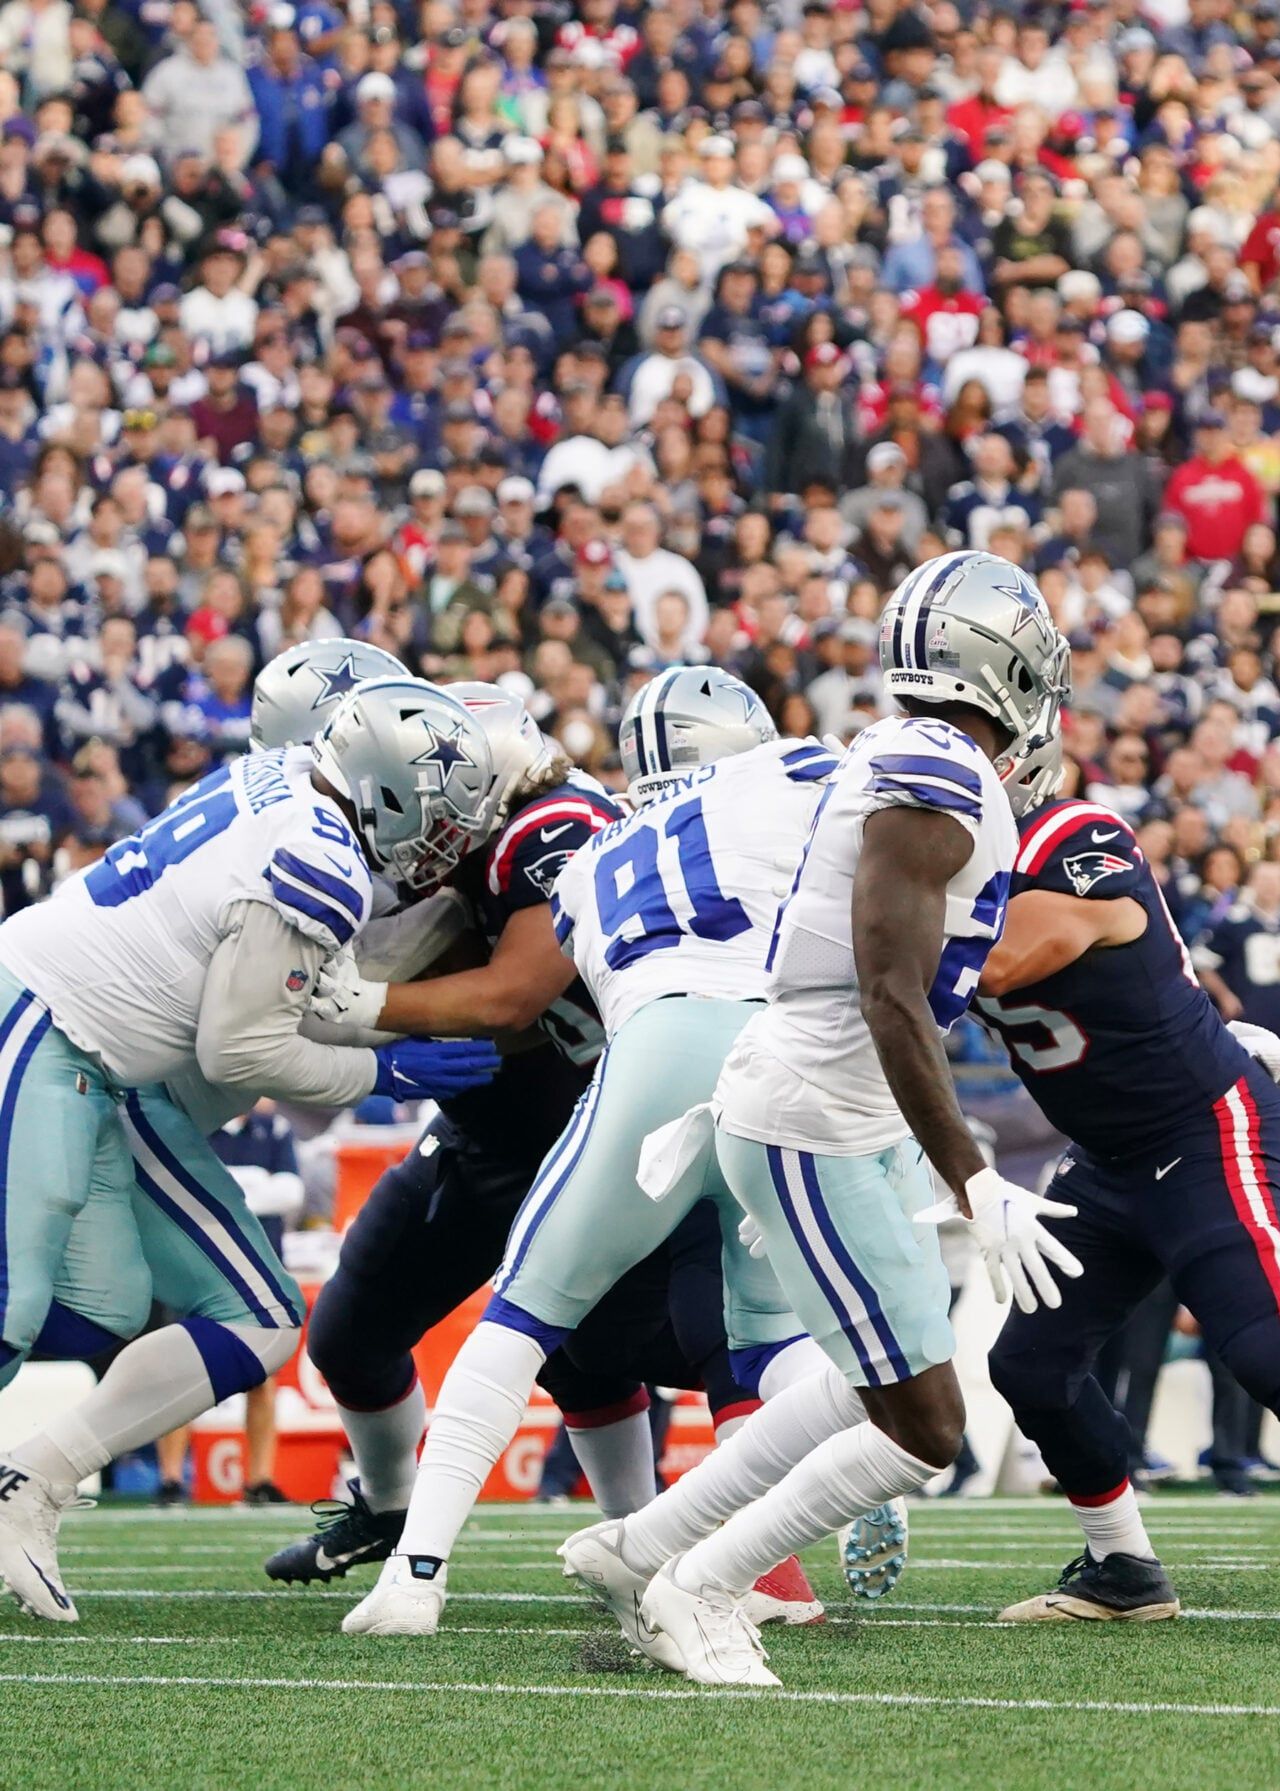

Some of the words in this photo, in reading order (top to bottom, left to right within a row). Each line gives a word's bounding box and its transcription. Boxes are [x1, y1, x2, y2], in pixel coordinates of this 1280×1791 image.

[891, 673, 934, 685] COWBOYS
[637, 778, 681, 794] COWBOY
[594, 796, 753, 971] 91
[207, 1438, 245, 1495] G
[504, 1435, 548, 1492] G
